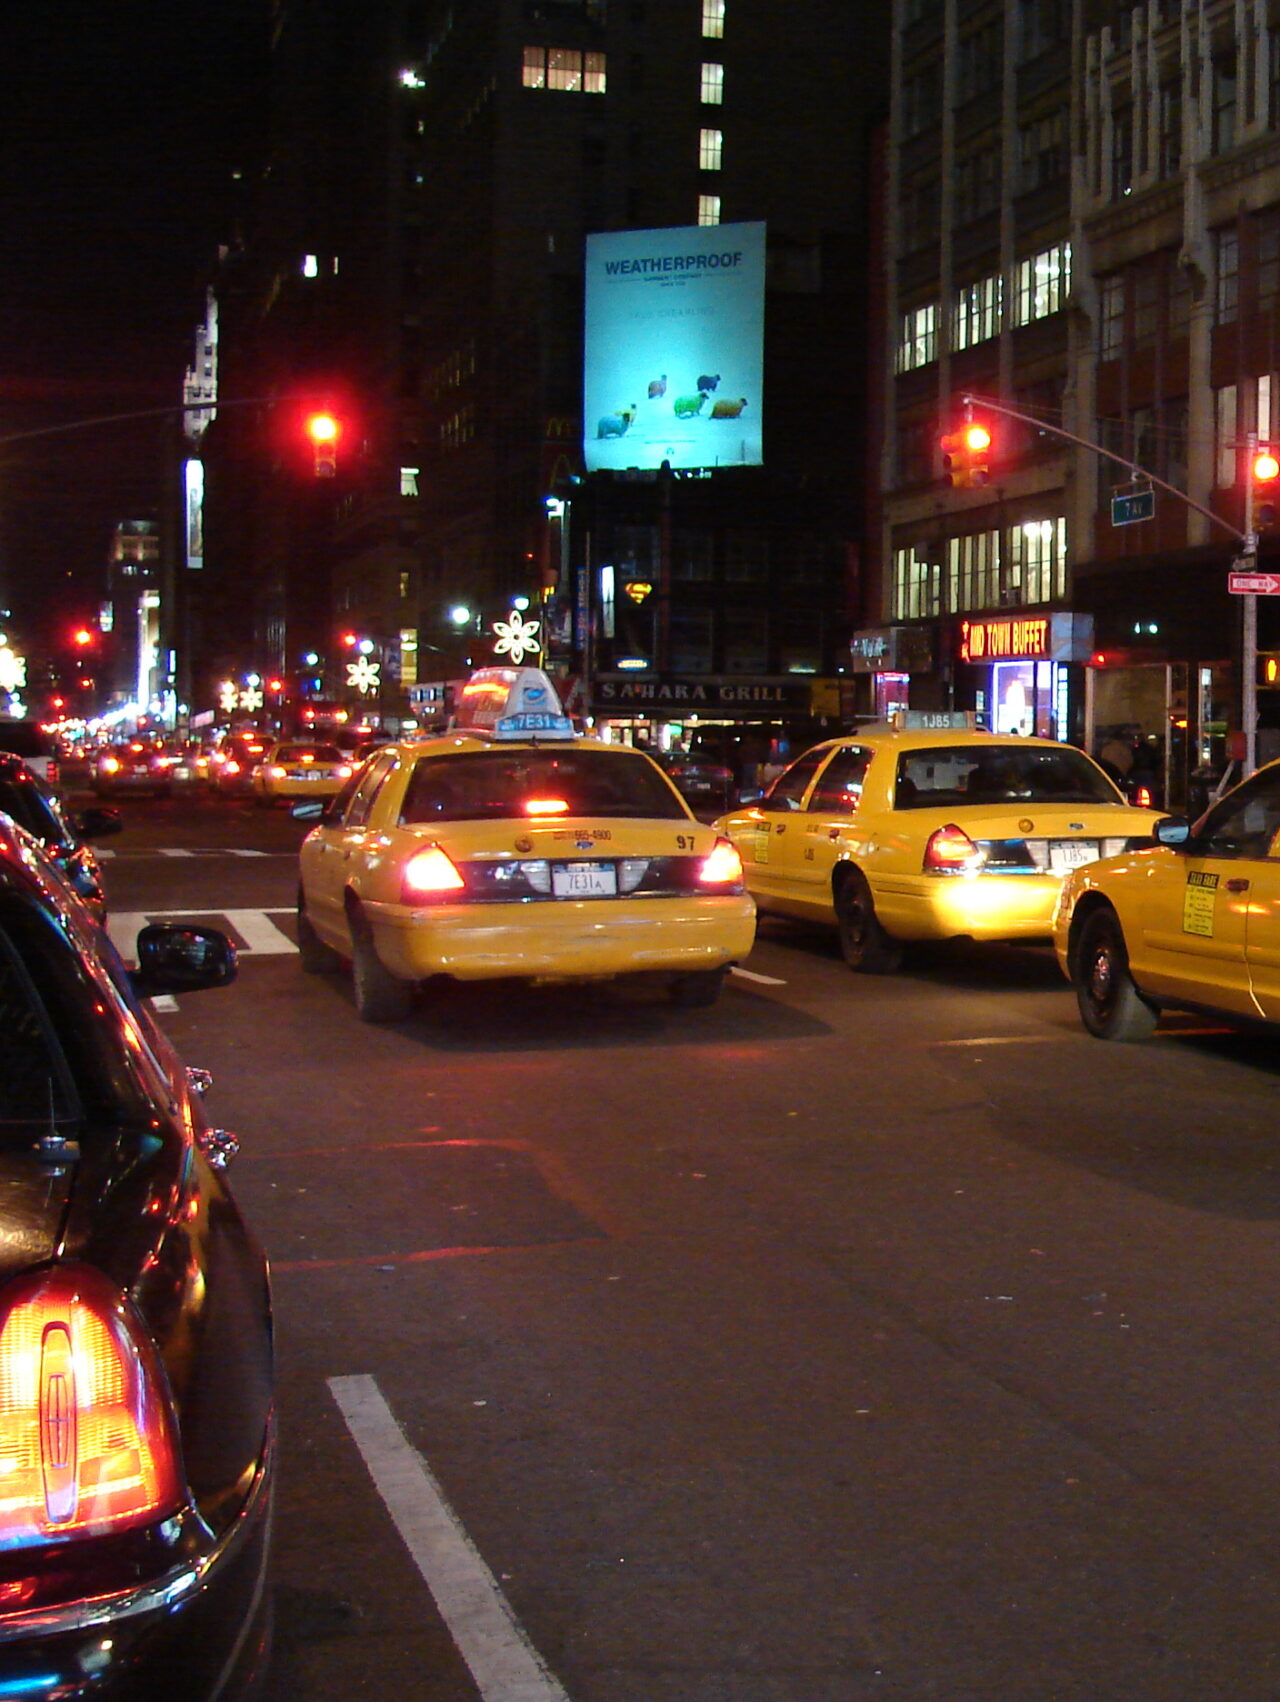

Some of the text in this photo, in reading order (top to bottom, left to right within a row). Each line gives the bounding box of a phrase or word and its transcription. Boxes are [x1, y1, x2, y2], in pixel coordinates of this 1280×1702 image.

[605, 252, 742, 275] WEATHERPROOF
[1125, 502, 1143, 517] 7 AV
[1236, 579, 1273, 588] ONE WAY
[970, 625, 984, 657] MID
[987, 622, 1010, 656] TOWN
[1013, 619, 1046, 654] BUFFET
[602, 683, 786, 701] SAHARA GRILL
[518, 715, 550, 728] 7E31
[922, 715, 950, 728] 1J85
[677, 835, 695, 850] 97
